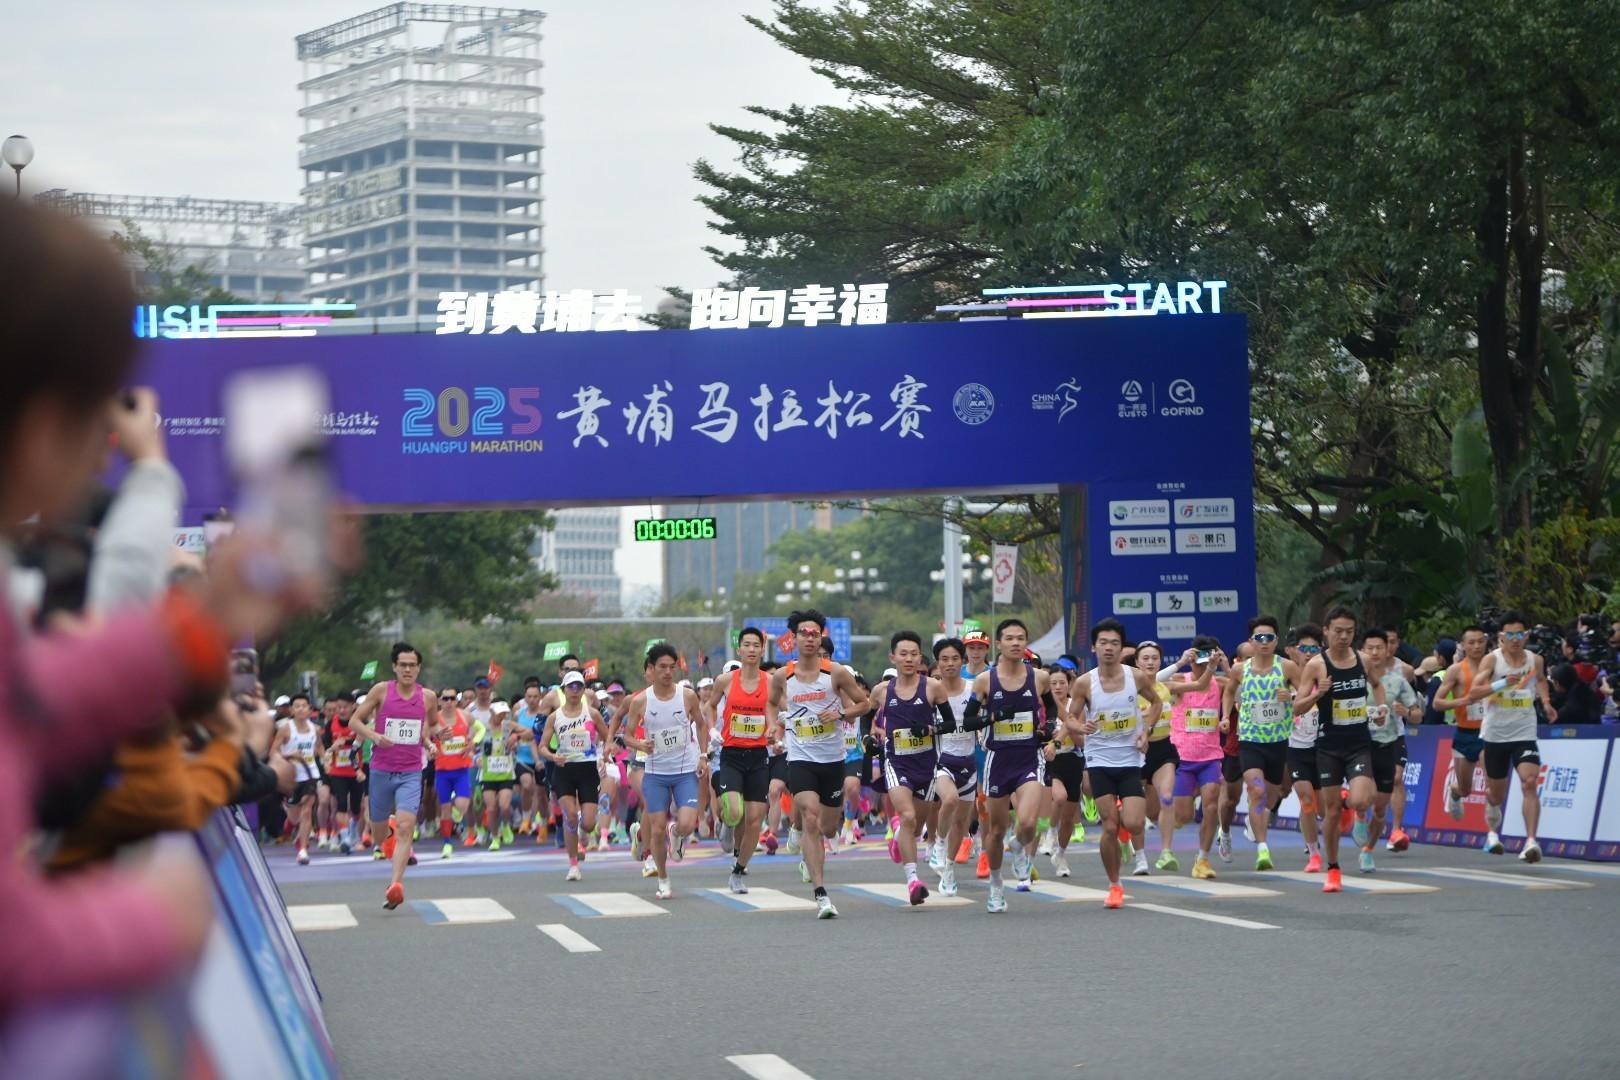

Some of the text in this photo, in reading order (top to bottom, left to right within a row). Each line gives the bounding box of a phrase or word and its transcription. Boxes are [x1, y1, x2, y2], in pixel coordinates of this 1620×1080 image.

[1104, 281, 1227, 315] START
[436, 283, 888, 334] 到黄埔去 跑向幸福
[1031, 394, 1061, 402] CHINA
[402, 386, 543, 437] 2025
[556, 374, 932, 448] 黄埔马拉松赛
[1118, 410, 1148, 418] GUSTO
[1161, 406, 1204, 417] GOFIND
[402, 439, 543, 455] HUANGPU MARATHON
[636, 518, 714, 540] 00:00:06
[1263, 709, 1278, 718] 006
[1347, 708, 1361, 718] 102
[1113, 719, 1128, 730] 107
[1199, 718, 1210, 726] 116
[744, 724, 755, 733] 115
[811, 725, 824, 735] 113
[1010, 723, 1023, 732] 112
[399, 729, 413, 738] 013
[571, 740, 584, 748] 022
[664, 736, 677, 746] 017
[909, 737, 923, 747] 105
